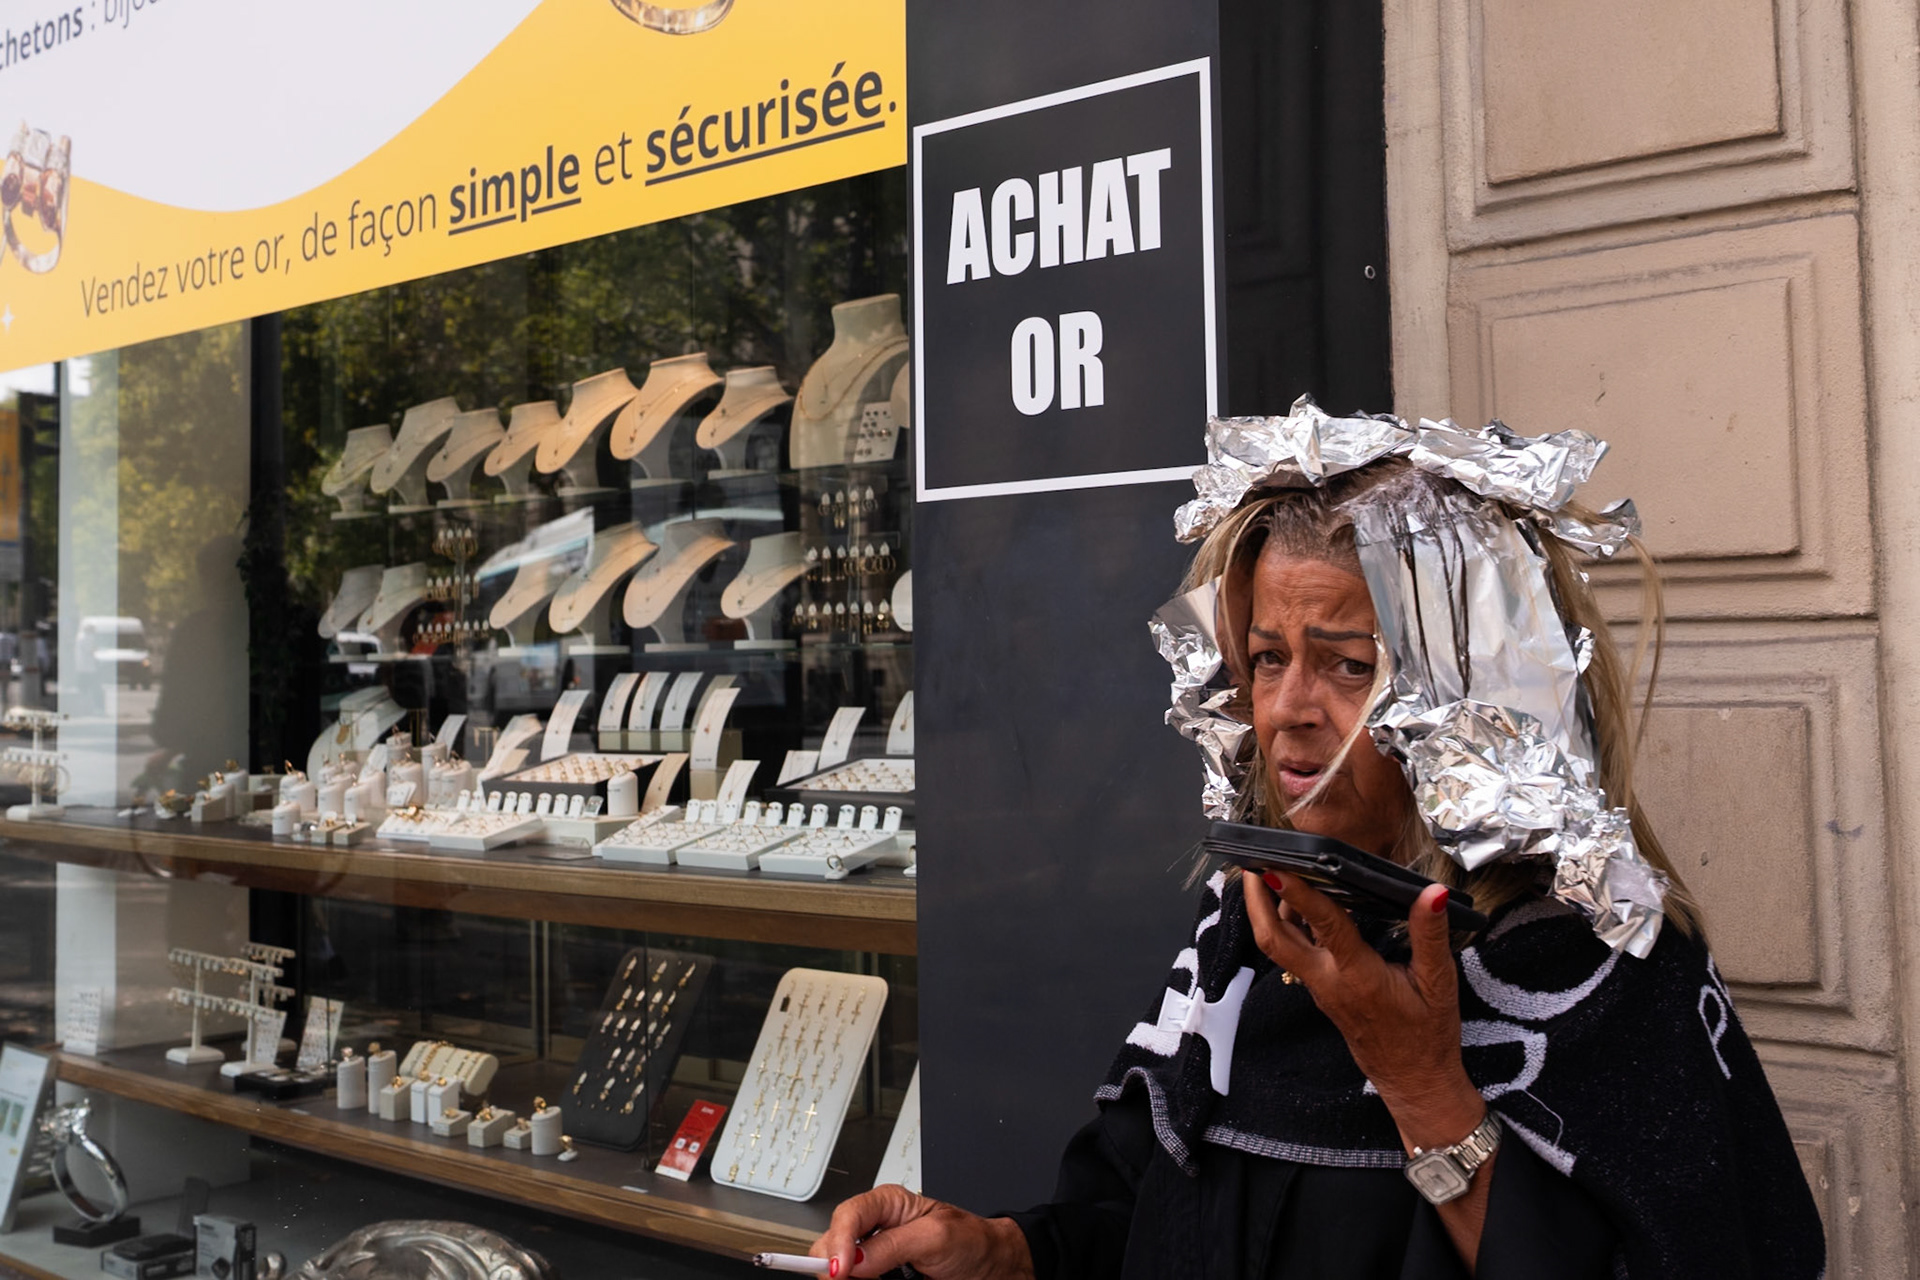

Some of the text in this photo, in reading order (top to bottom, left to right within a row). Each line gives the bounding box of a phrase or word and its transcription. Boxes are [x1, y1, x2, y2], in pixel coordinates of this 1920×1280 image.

[81, 61, 897, 318] Vendez votre or, de façon simple et sécurisée.
[947, 147, 1172, 285] ACHAT
[1011, 310, 1105, 416] OR
